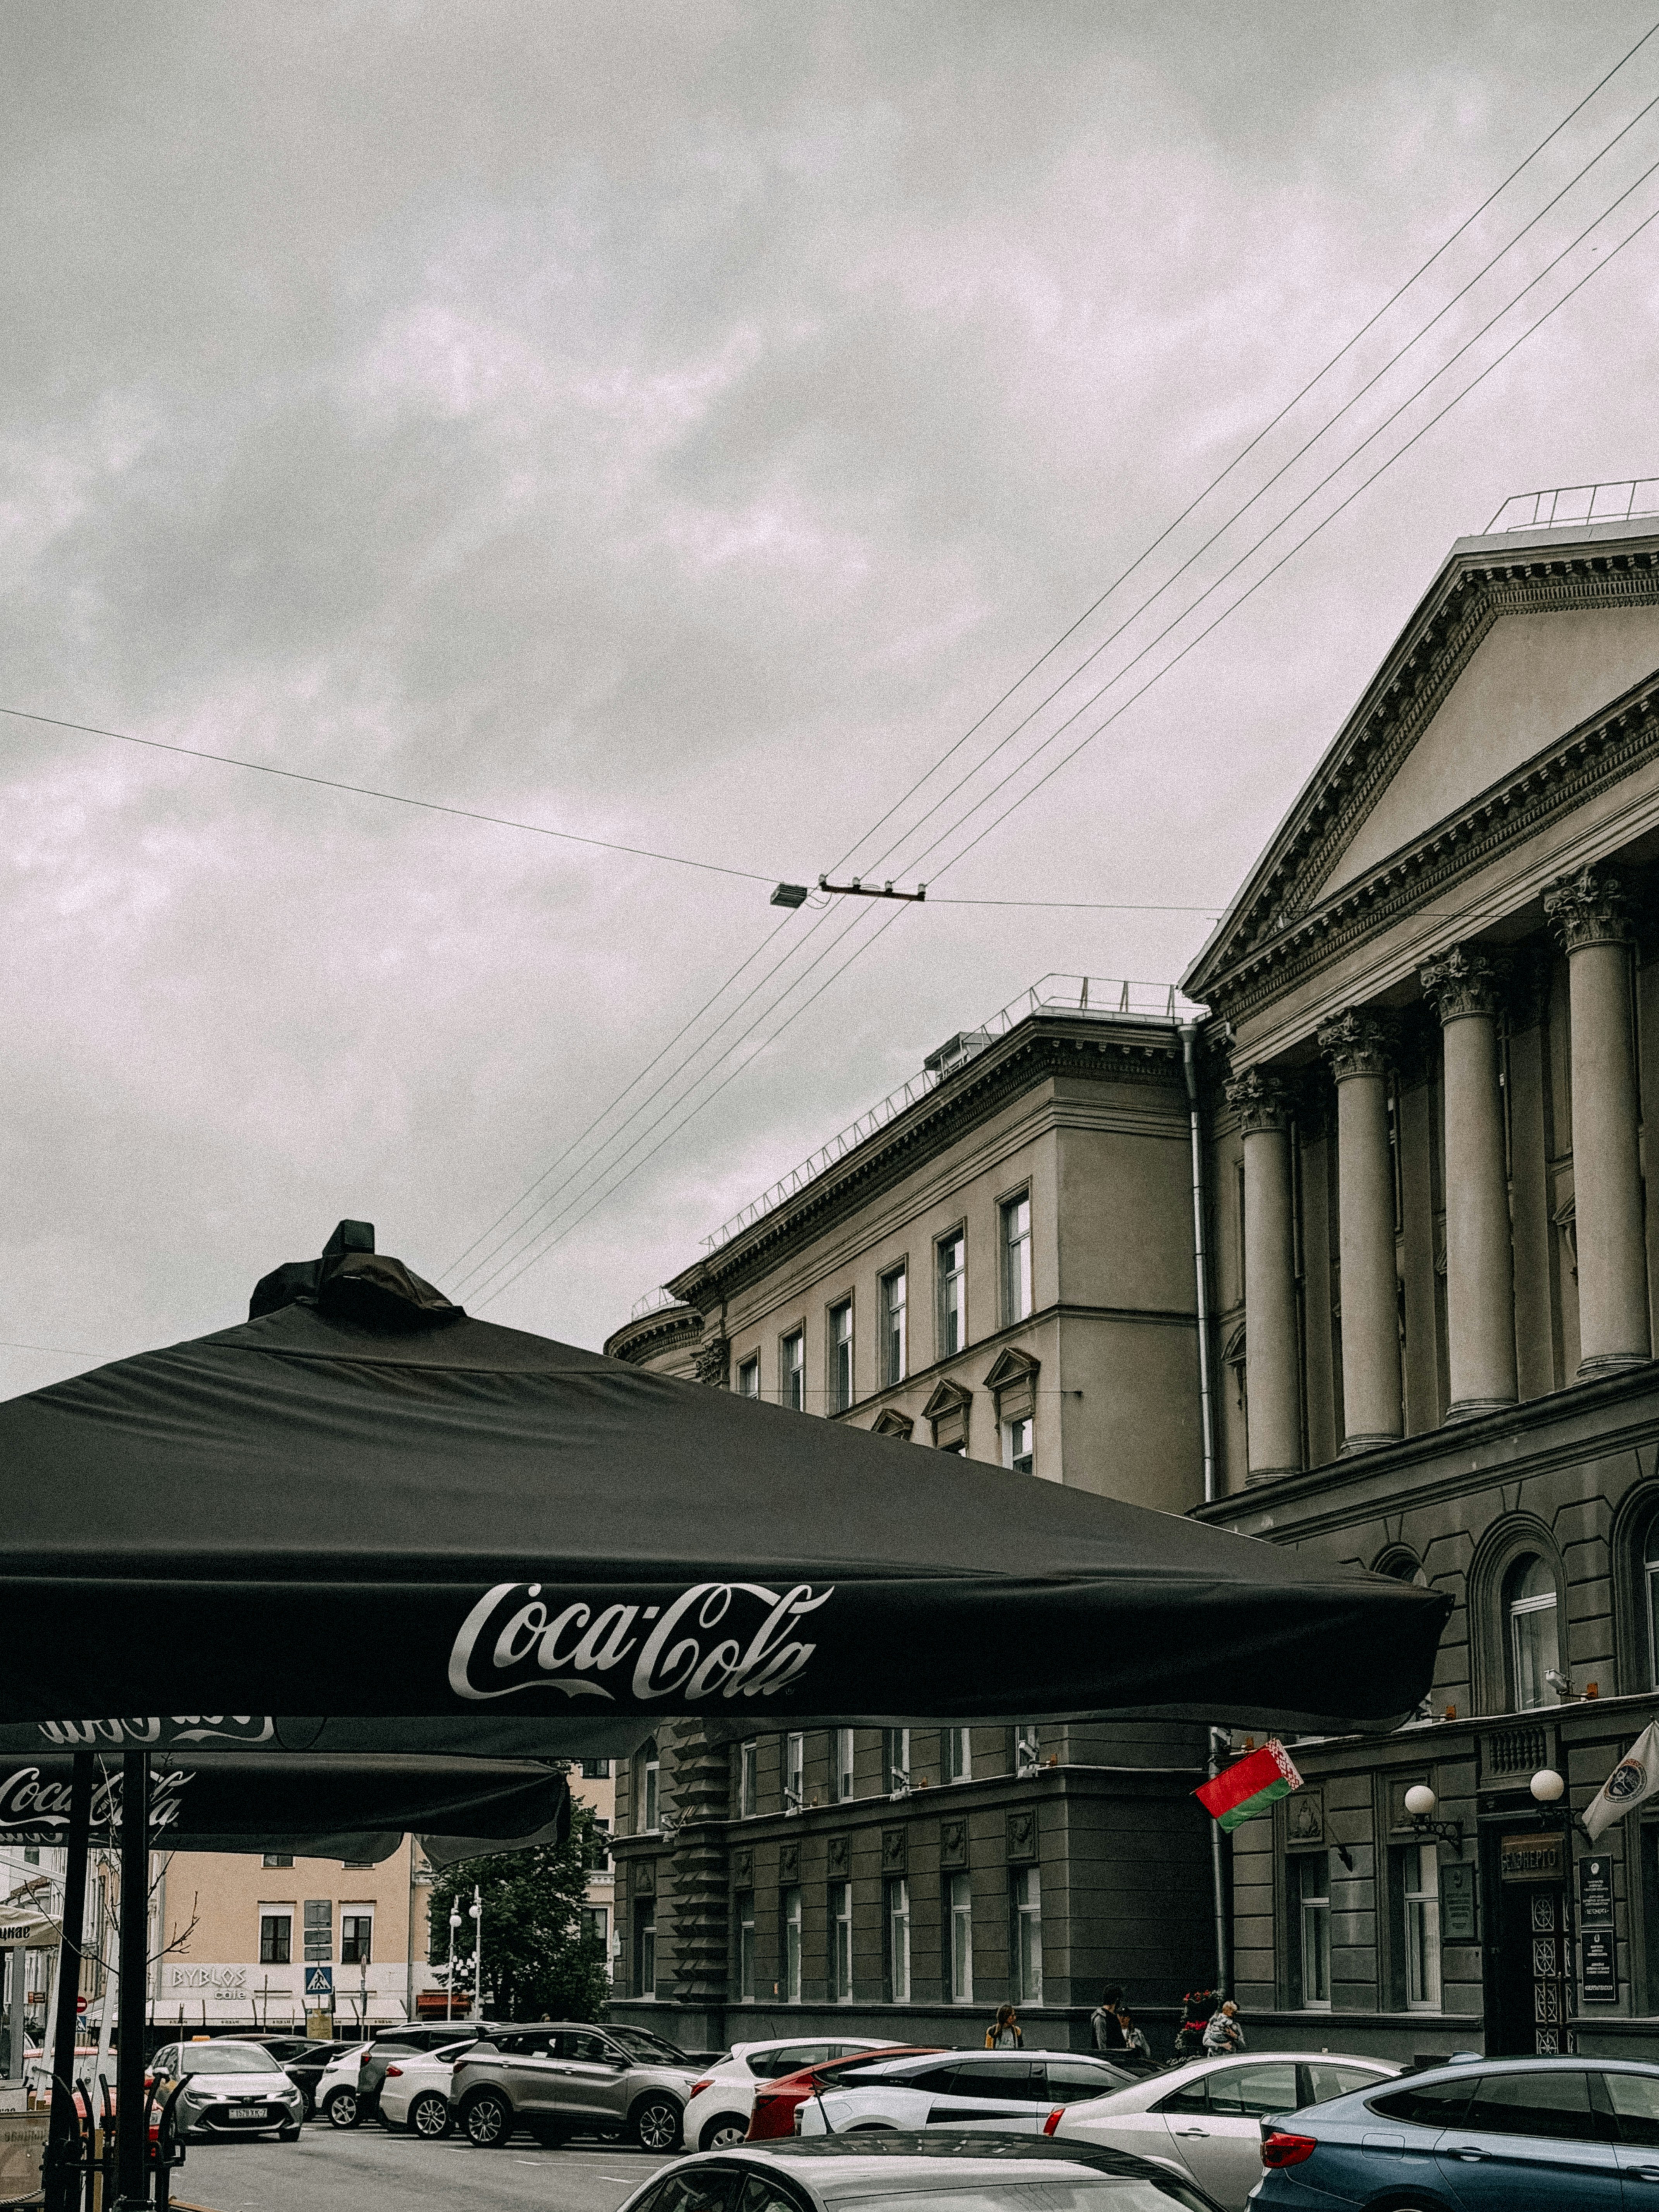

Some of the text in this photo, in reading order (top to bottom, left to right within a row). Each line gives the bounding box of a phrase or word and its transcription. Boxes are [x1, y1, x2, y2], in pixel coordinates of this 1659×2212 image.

[448, 1583, 835, 1700] Coca-Cola
[172, 1968, 246, 1987] BYBLOS
[215, 1990, 246, 2000] cafe
